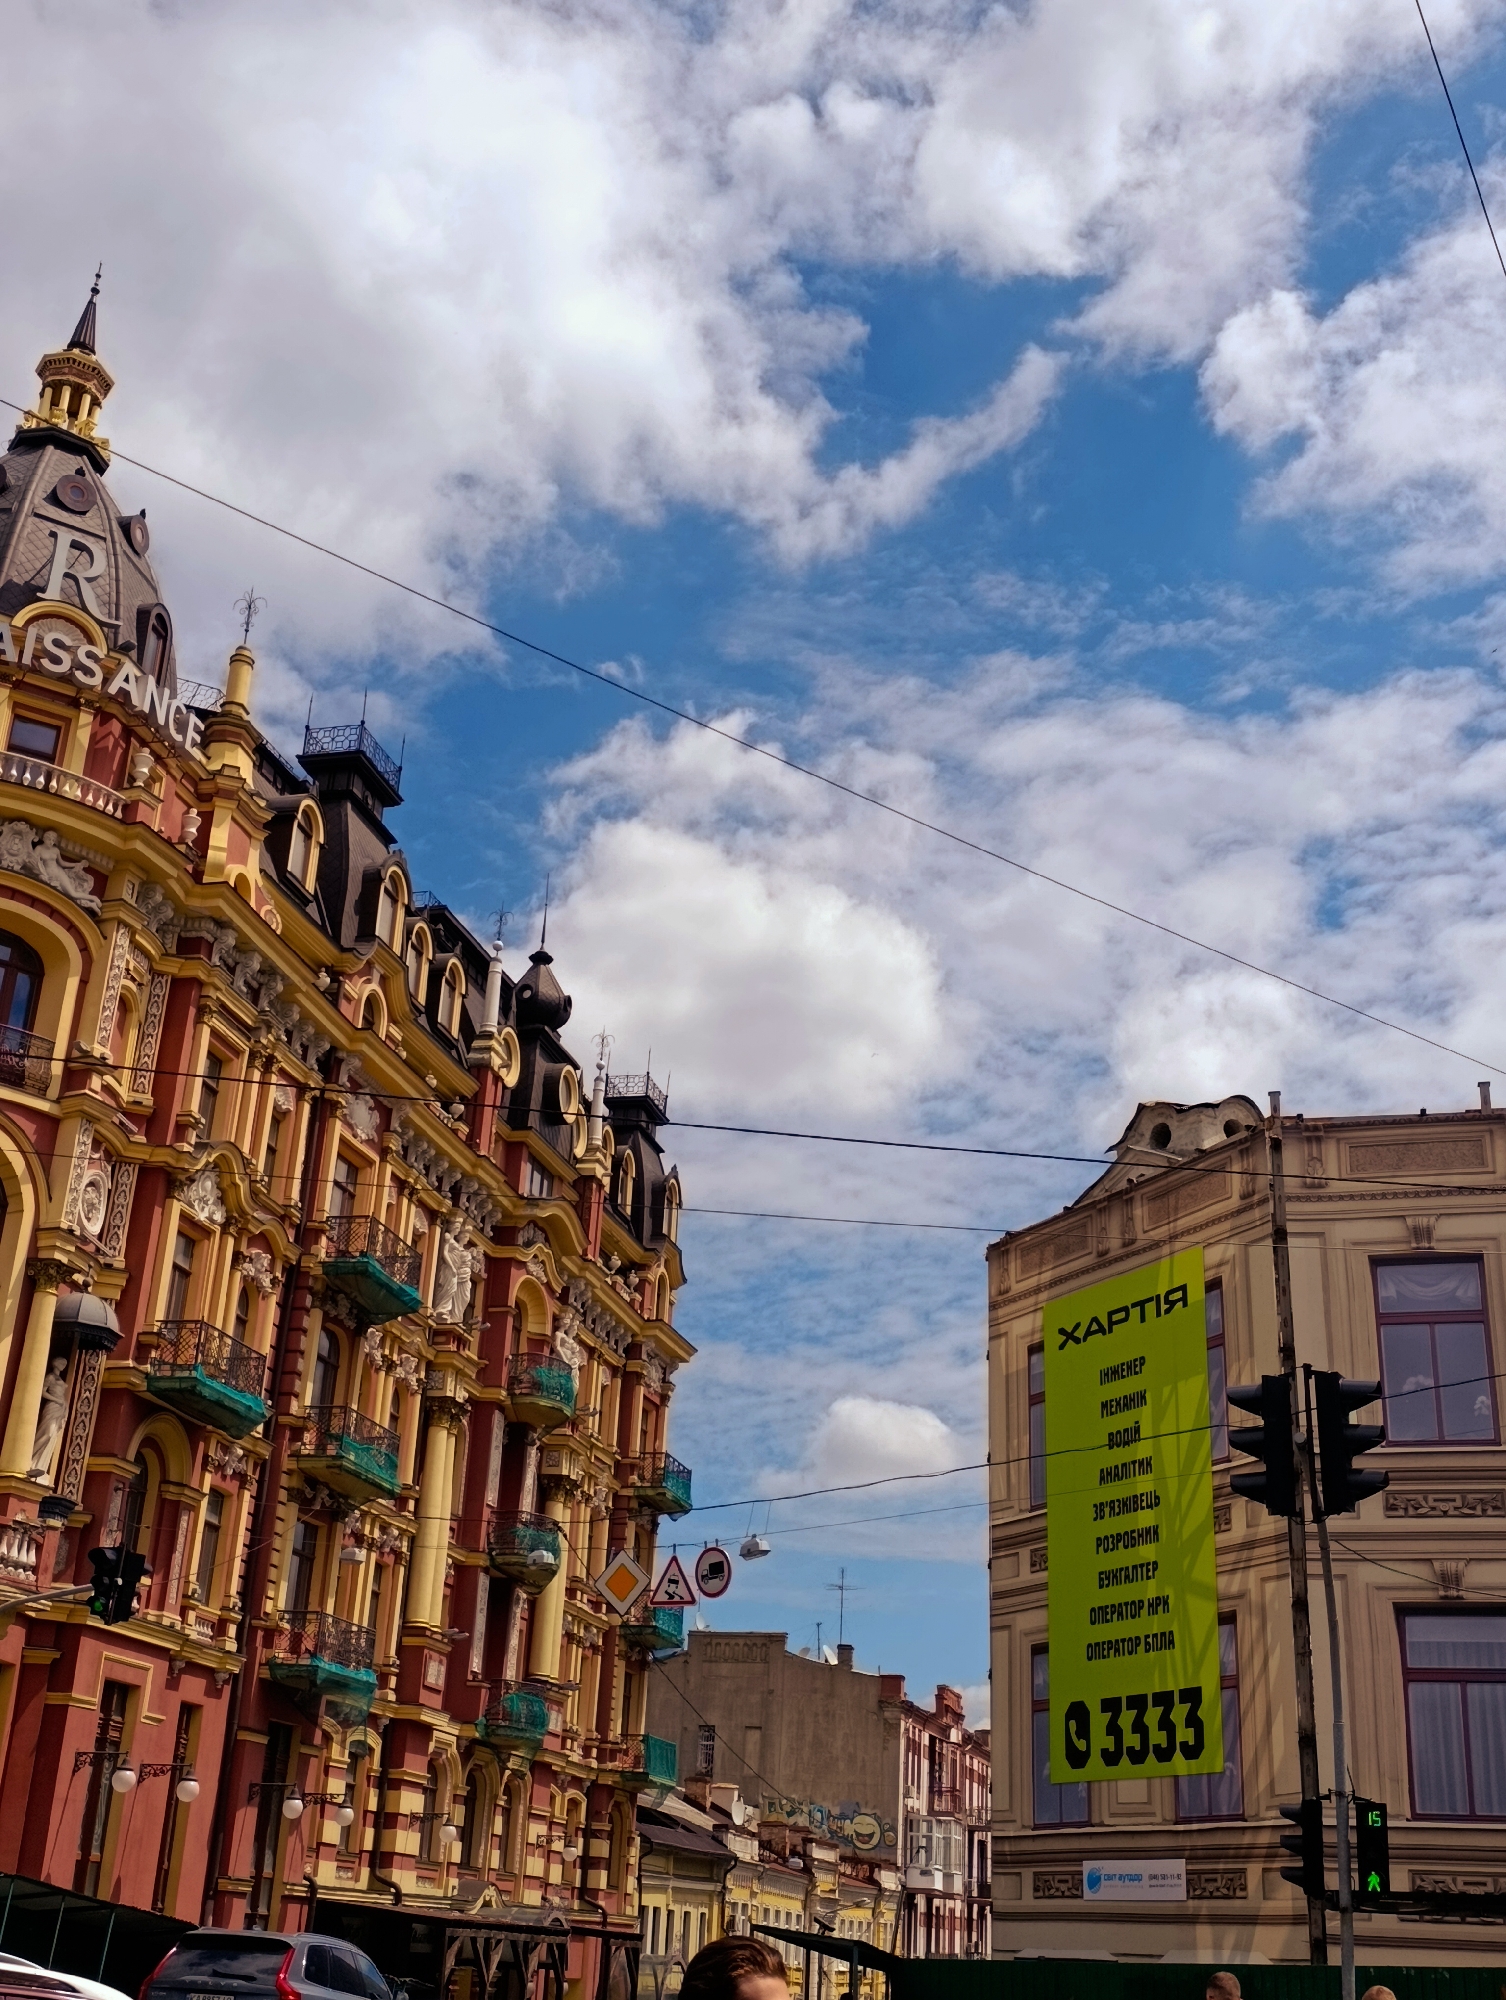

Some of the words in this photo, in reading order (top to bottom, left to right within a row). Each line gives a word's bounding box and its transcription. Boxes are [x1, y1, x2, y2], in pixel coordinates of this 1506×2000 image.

[37, 529, 122, 629] R
[1057, 1284, 1189, 1351] ХАРТІЯ
[1099, 1356, 1146, 1386] ІНЖЕНЕР
[1100, 1389, 1147, 1419] МЕХАНІК
[1107, 1420, 1141, 1451] ВОДІЙ
[1098, 1456, 1153, 1487] АНАЛІТИК
[1095, 1525, 1160, 1555] РОЗРОБНИК
[1098, 1561, 1159, 1590] БУХГАЛТЕР
[1089, 1600, 1145, 1626] ОПЕРАТОР
[1147, 1594, 1170, 1617] НРК
[1086, 1634, 1142, 1662] ОПЕРАТОР
[1143, 1629, 1176, 1655] БПЛА
[1100, 1685, 1205, 1768] 3333
[1368, 1811, 1382, 1827] 15
